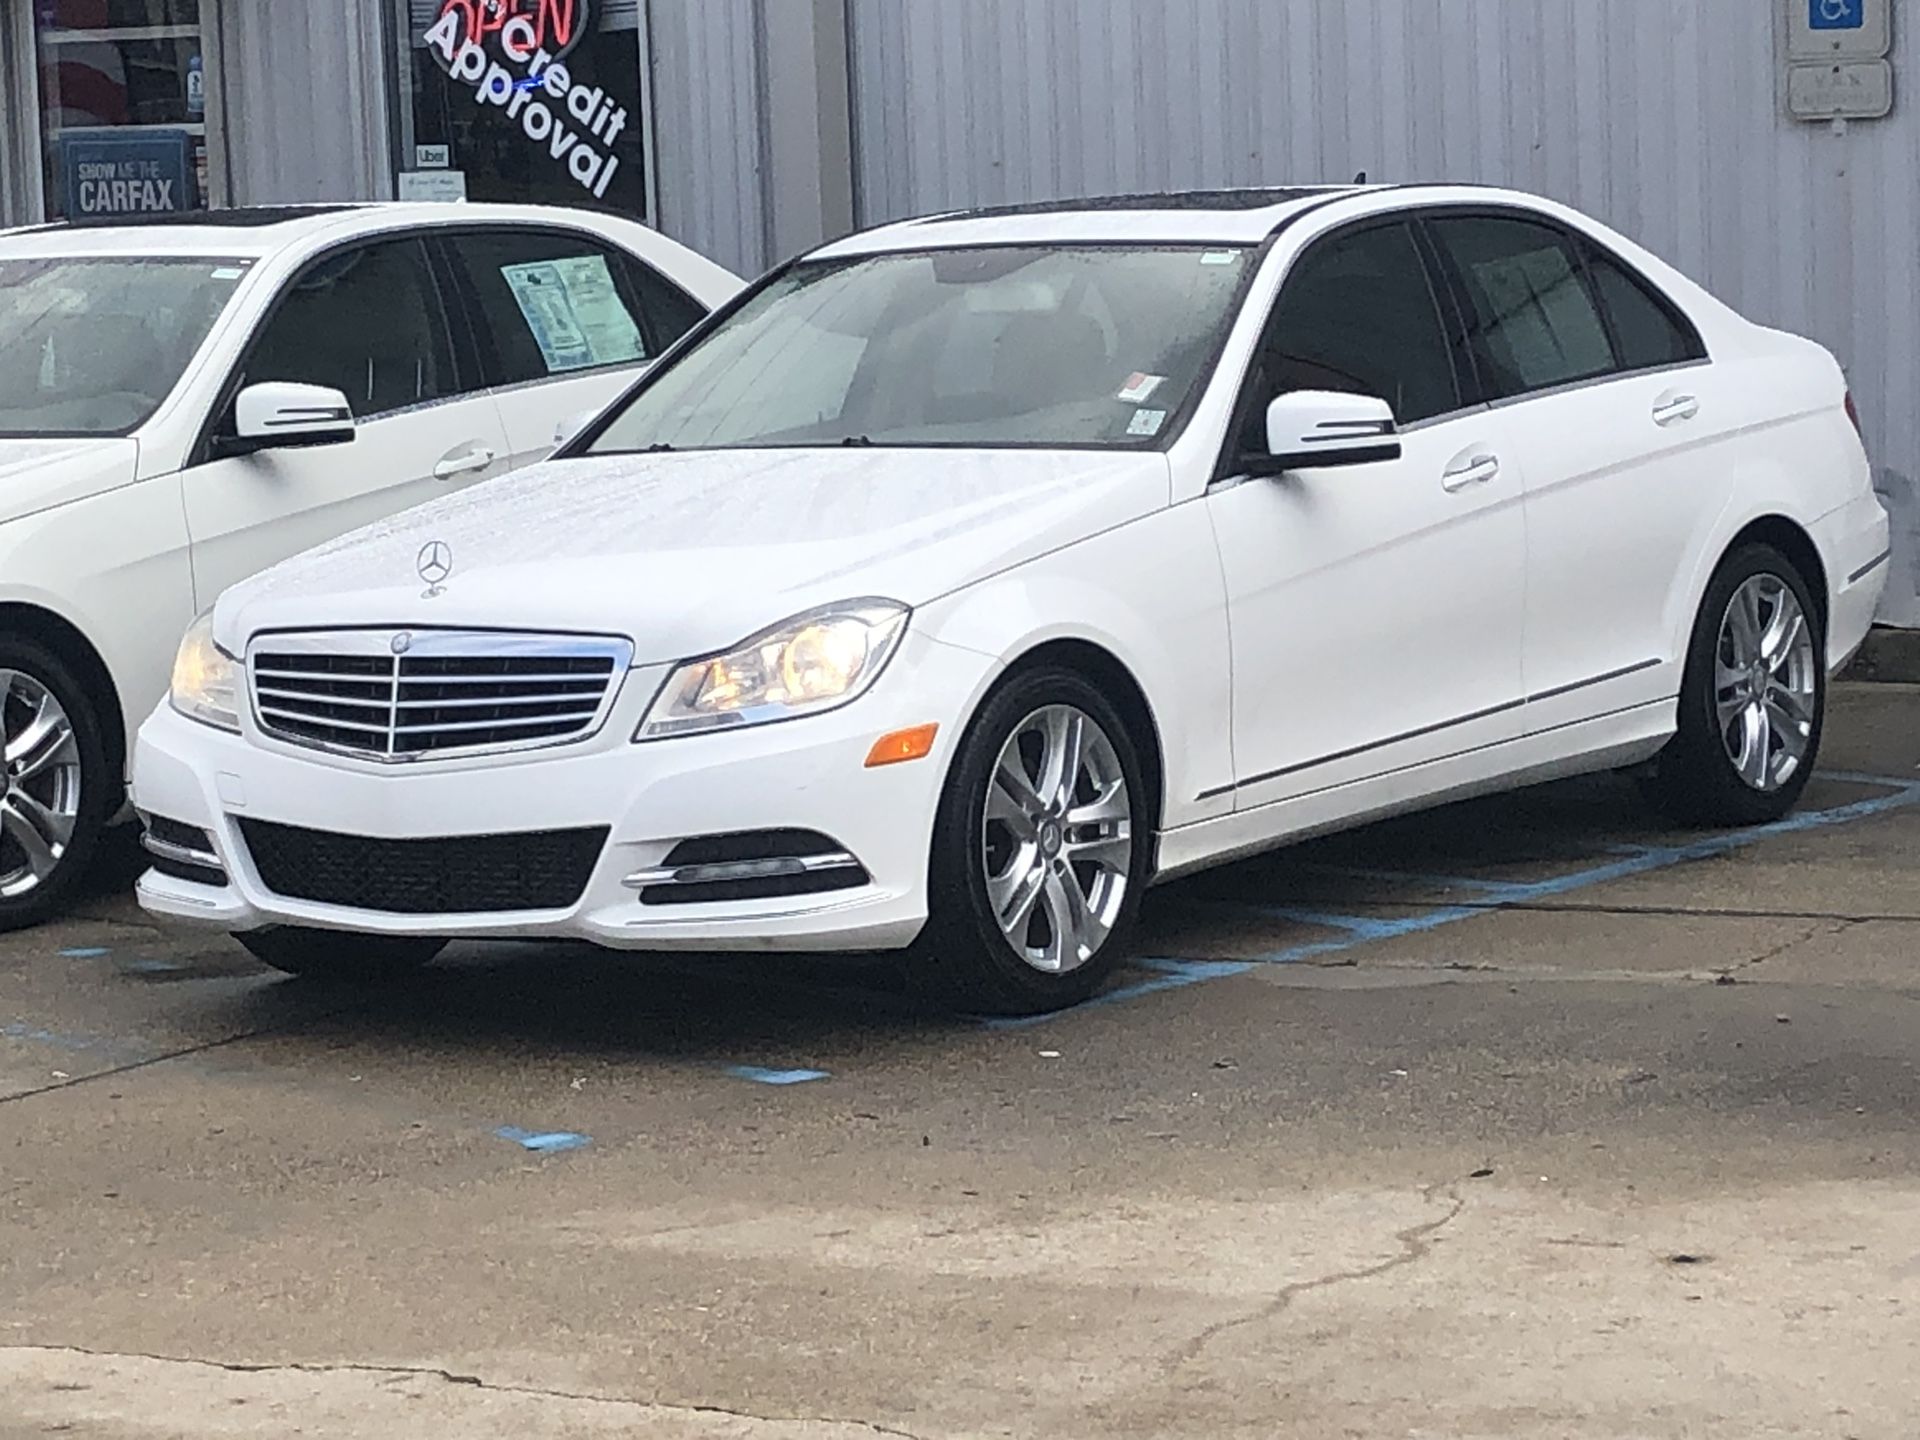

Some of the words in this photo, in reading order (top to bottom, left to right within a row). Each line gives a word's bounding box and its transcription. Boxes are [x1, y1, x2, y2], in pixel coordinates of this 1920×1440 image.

[501, 16, 627, 147] Credit
[423, 10, 619, 199] Approval
[78, 162, 116, 180] SHOW
[118, 162, 135, 179] ME
[138, 160, 160, 179] THE
[418, 149, 445, 163] Uber
[80, 179, 174, 212] CARFAX
